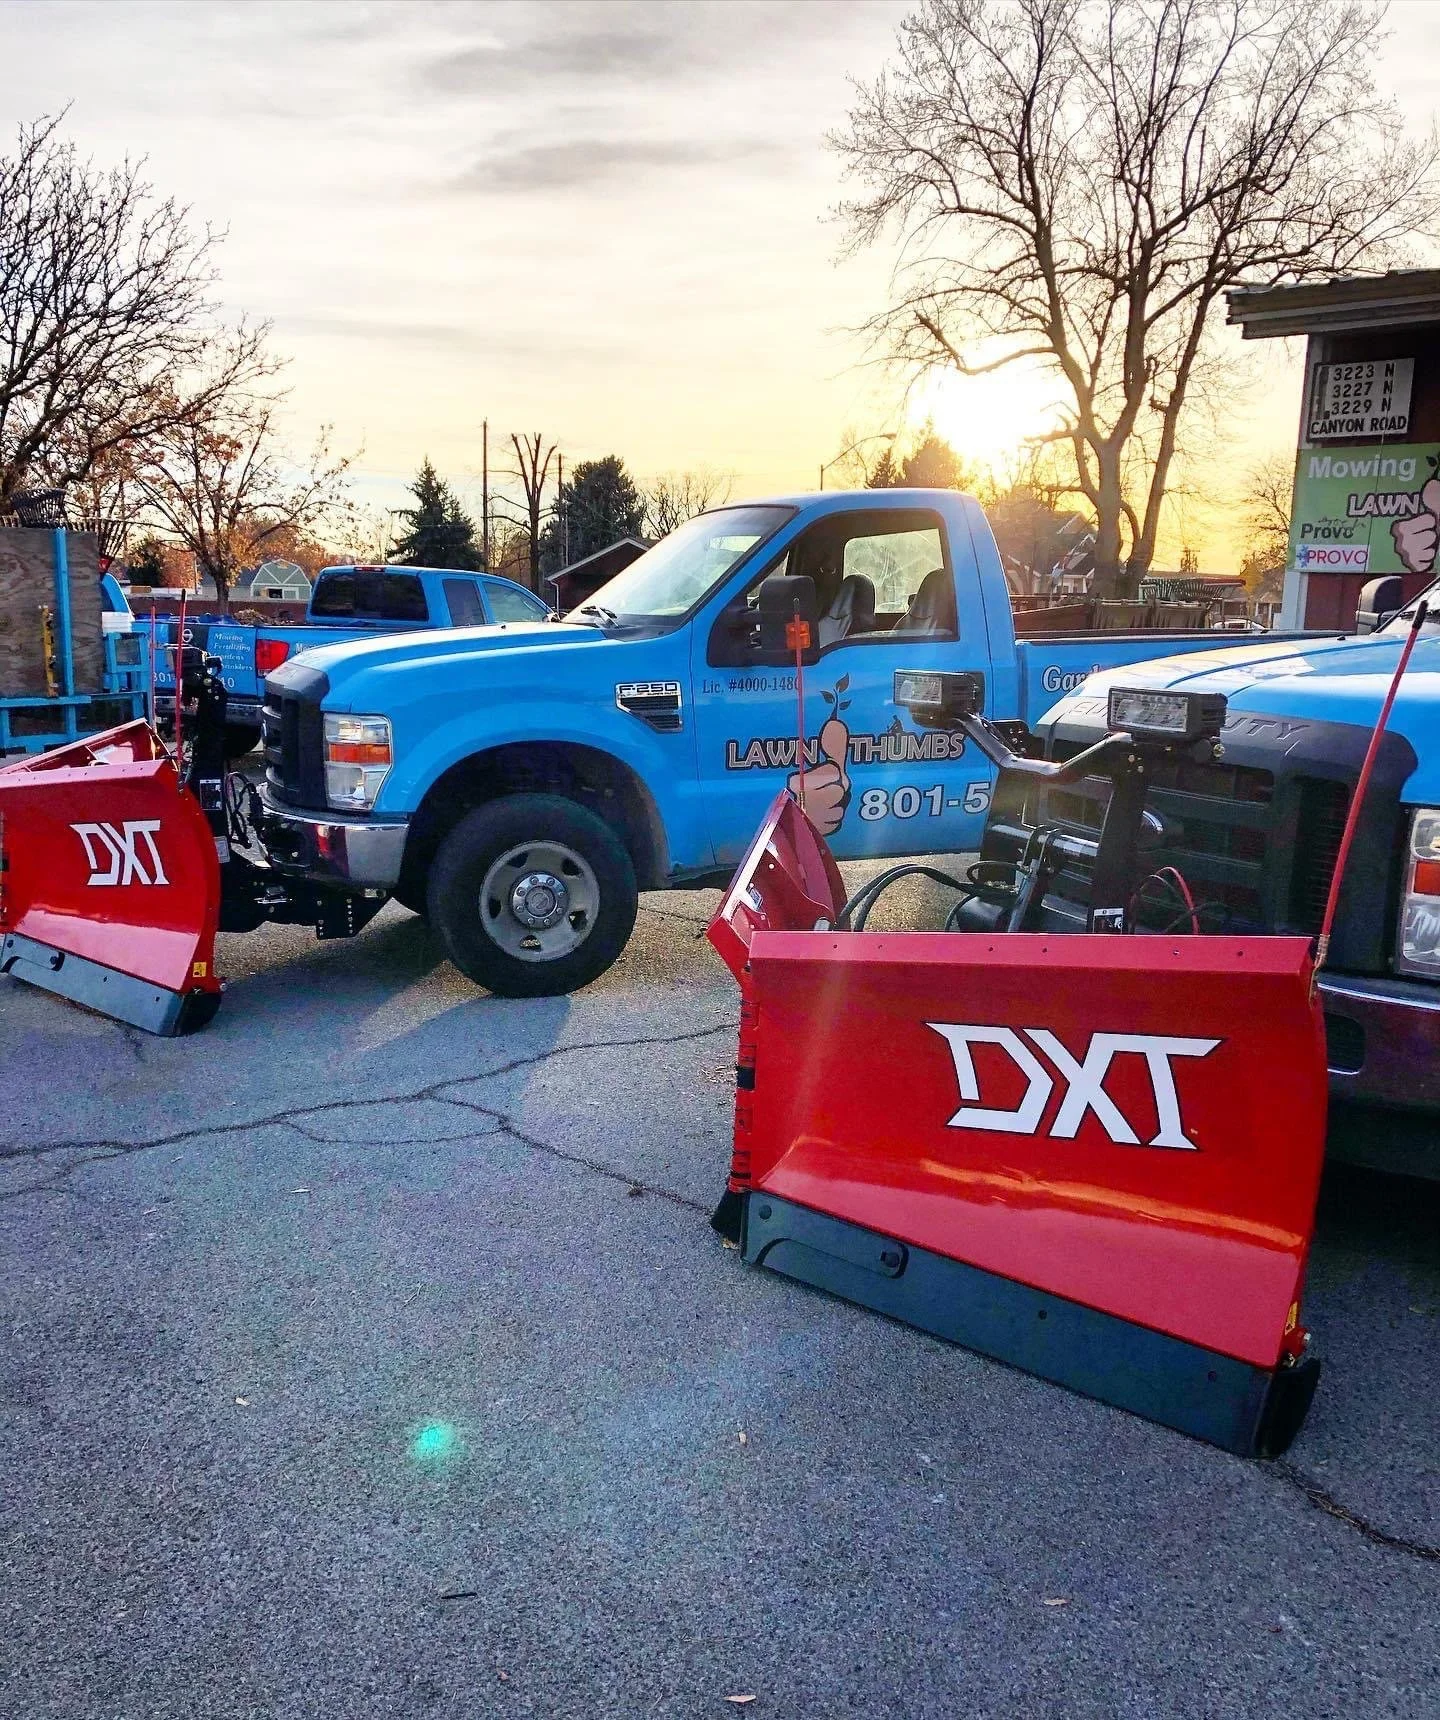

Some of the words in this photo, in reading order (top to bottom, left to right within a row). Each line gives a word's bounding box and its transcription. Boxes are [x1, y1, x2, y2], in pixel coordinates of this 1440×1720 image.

[1333, 365, 1374, 381] 3223
[1385, 363, 1395, 377] N
[1333, 382, 1373, 398] 3227
[1383, 381, 1393, 394] N
[1331, 400, 1372, 415] 3229
[1381, 398, 1392, 412] N
[1311, 418, 1365, 434] CANYON
[1370, 416, 1406, 431] ROAD
[1308, 454, 1417, 482] Mowing
[1347, 493, 1421, 517] LAWN
[1300, 523, 1354, 539] Provo
[1306, 550, 1368, 565] PROVO
[619, 682, 678, 694] F-250
[702, 679, 724, 694] Lic.
[727, 737, 819, 769] LAWN
[849, 732, 966, 763] THUMBS
[860, 783, 990, 822] 801-5
[69, 819, 170, 886] DXT
[924, 1022, 1223, 1150] DXT
